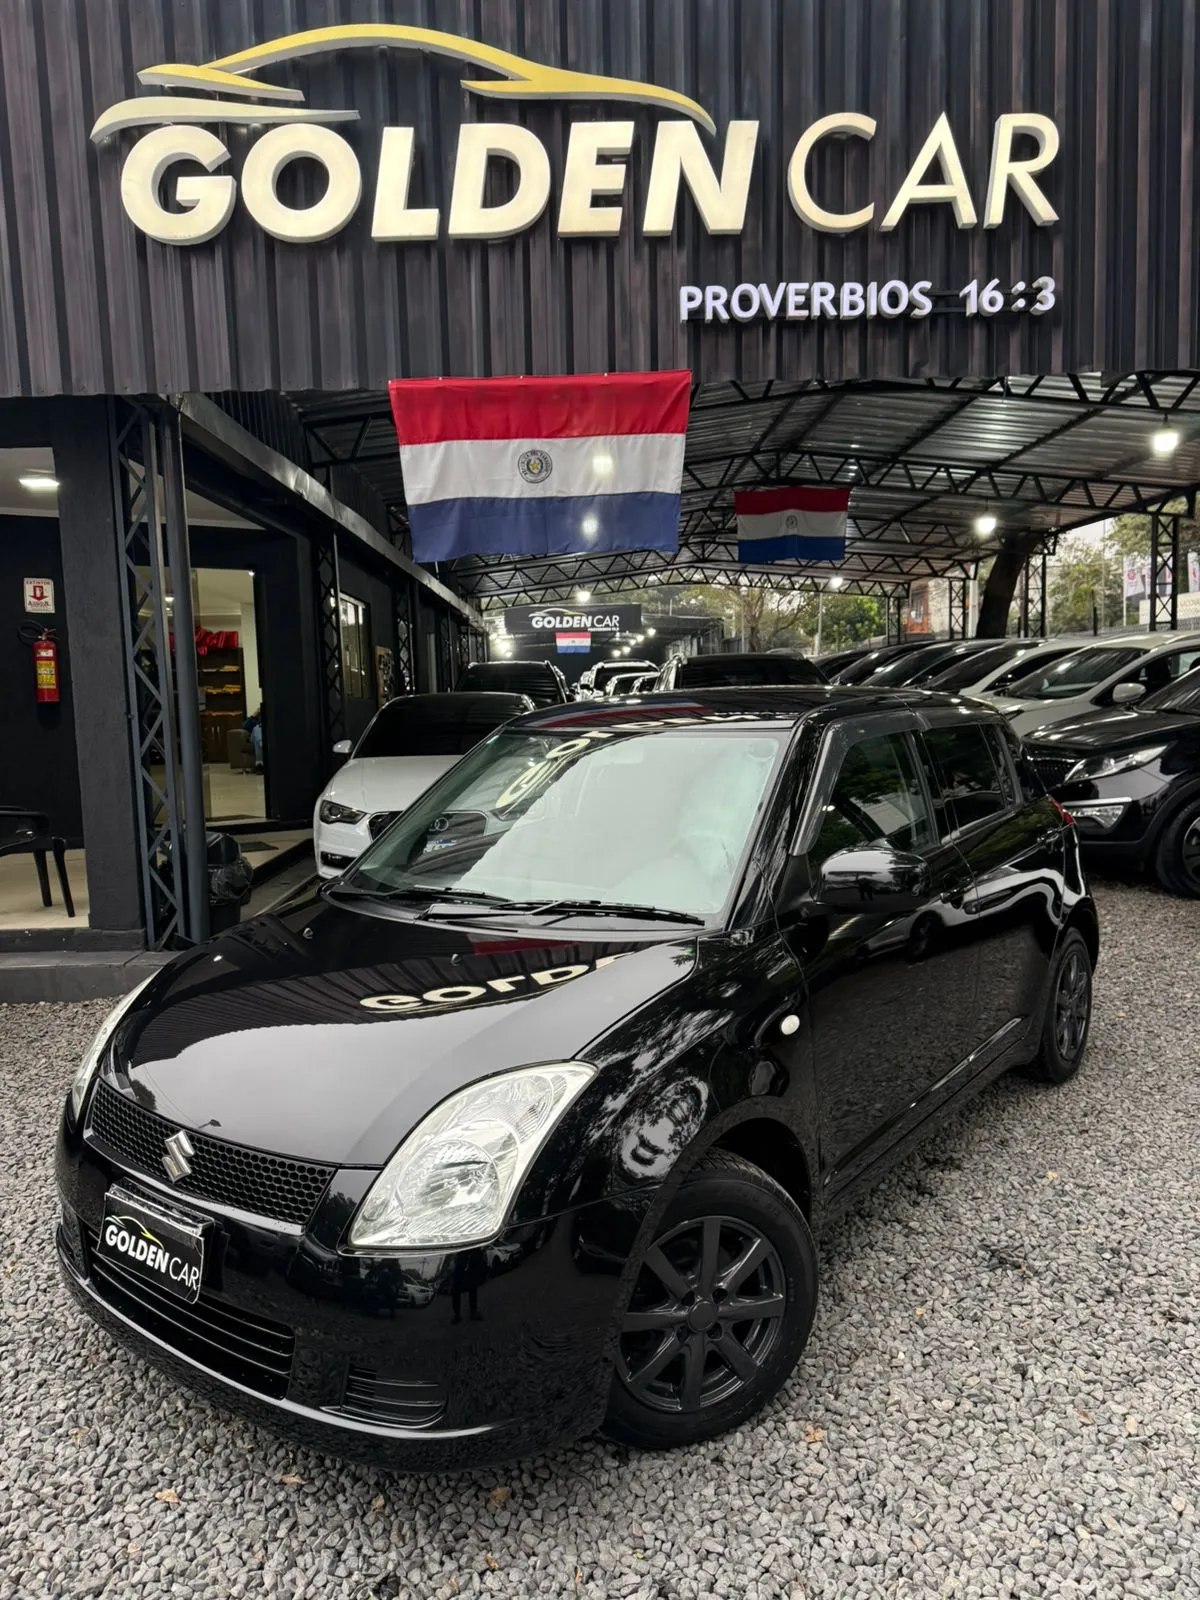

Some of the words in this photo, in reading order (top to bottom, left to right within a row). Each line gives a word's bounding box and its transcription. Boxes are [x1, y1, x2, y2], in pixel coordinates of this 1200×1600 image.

[121, 120, 758, 246] GOLDEN
[787, 111, 1061, 234] CAR
[680, 279, 932, 323] PROVERBIOS
[960, 275, 1056, 317] 16:3
[531, 615, 592, 629] GOLDEN
[593, 614, 620, 628] CAR
[105, 1225, 170, 1274] GOLDEN
[169, 1257, 199, 1290] CAR
